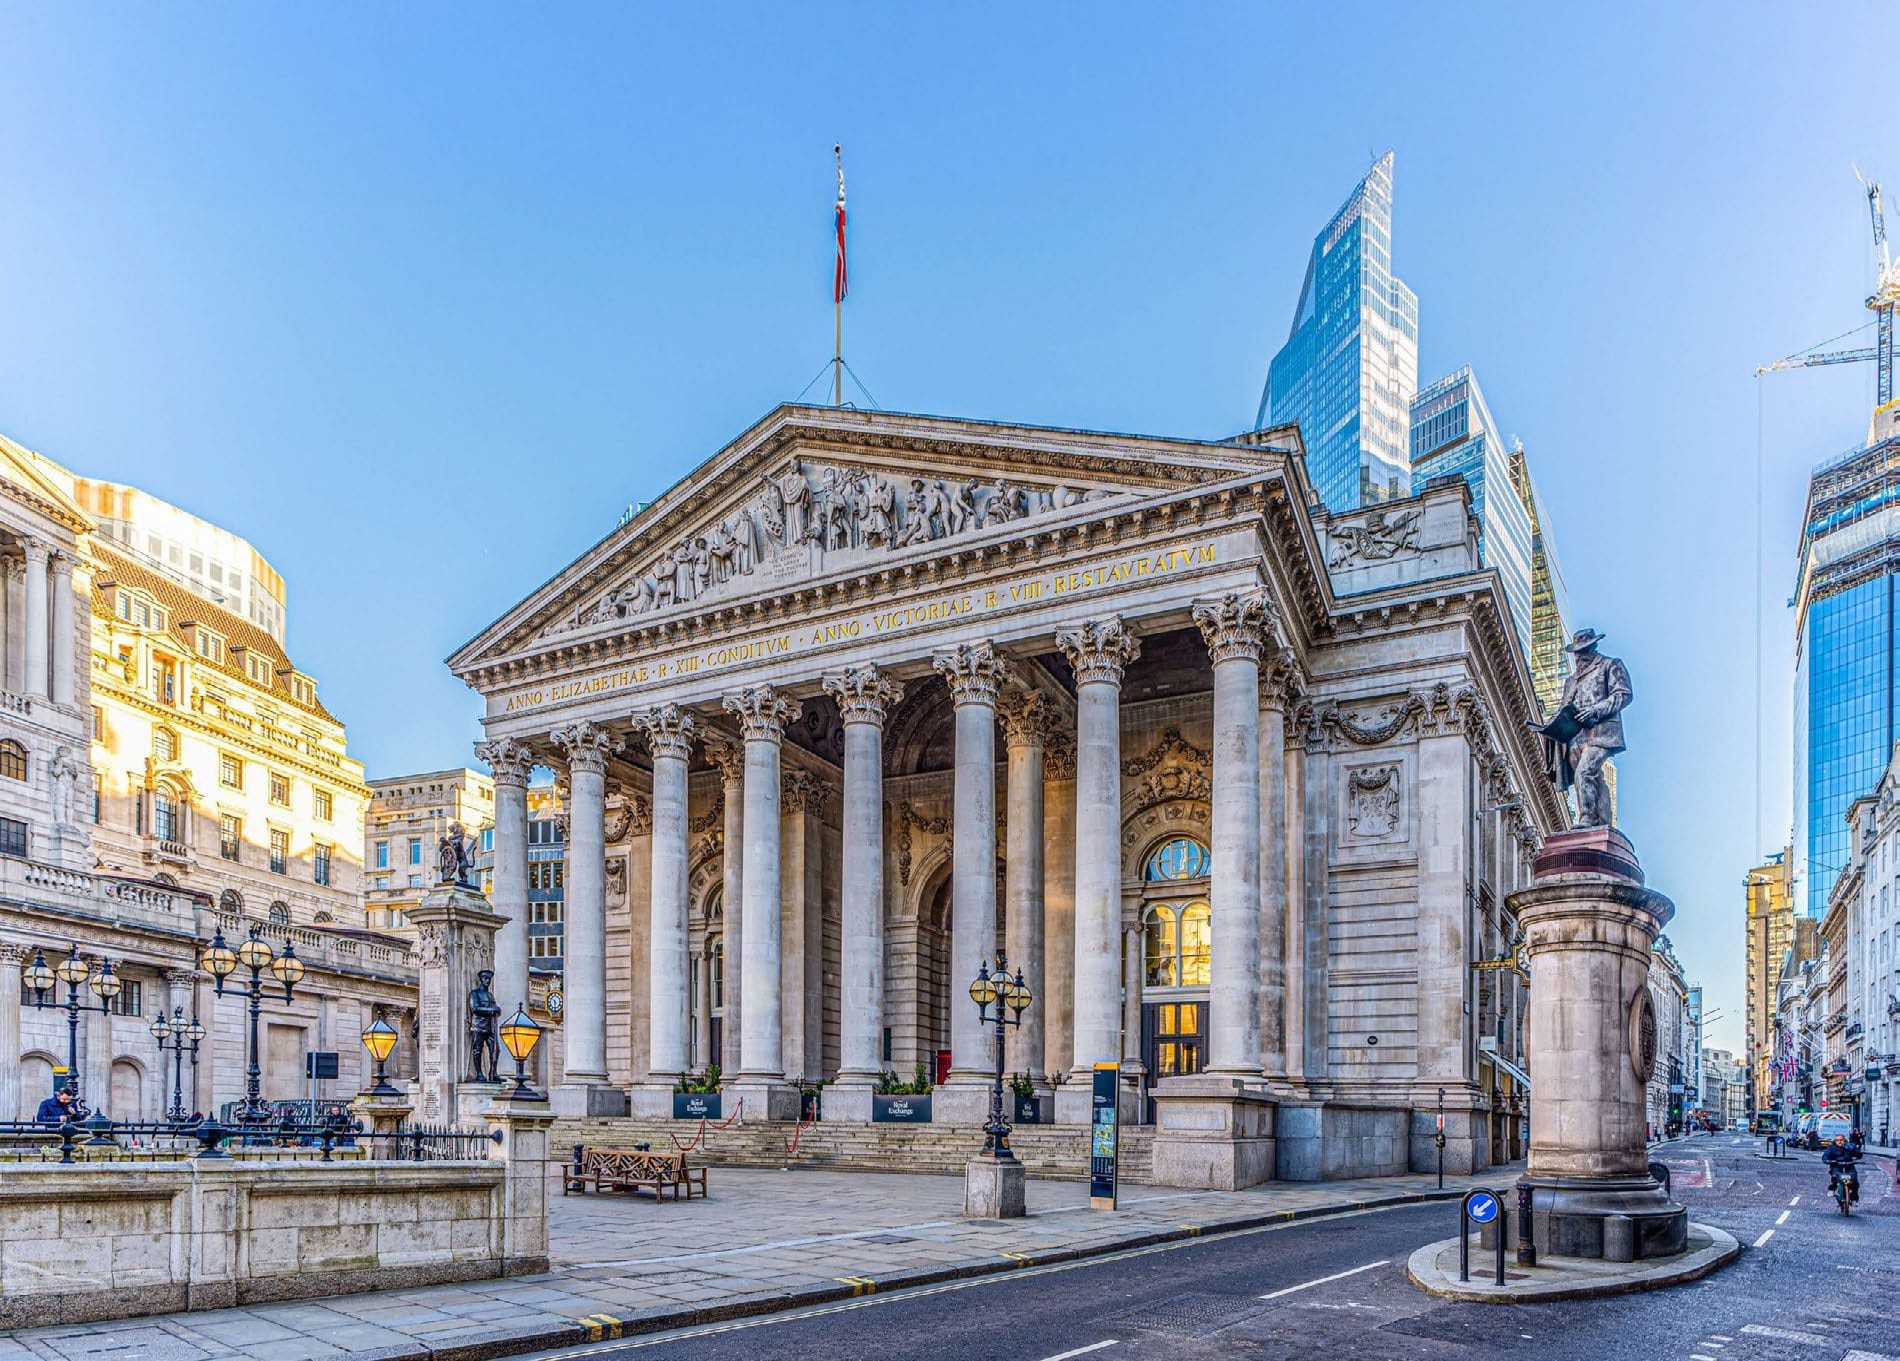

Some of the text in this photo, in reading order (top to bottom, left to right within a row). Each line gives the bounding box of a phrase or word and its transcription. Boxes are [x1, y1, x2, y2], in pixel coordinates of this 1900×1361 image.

[506, 544, 1216, 711] ANNO ELIZABETHAE R XIII CONDITVM ANNO VICTORIAE R VIII RESTAVRATVM
